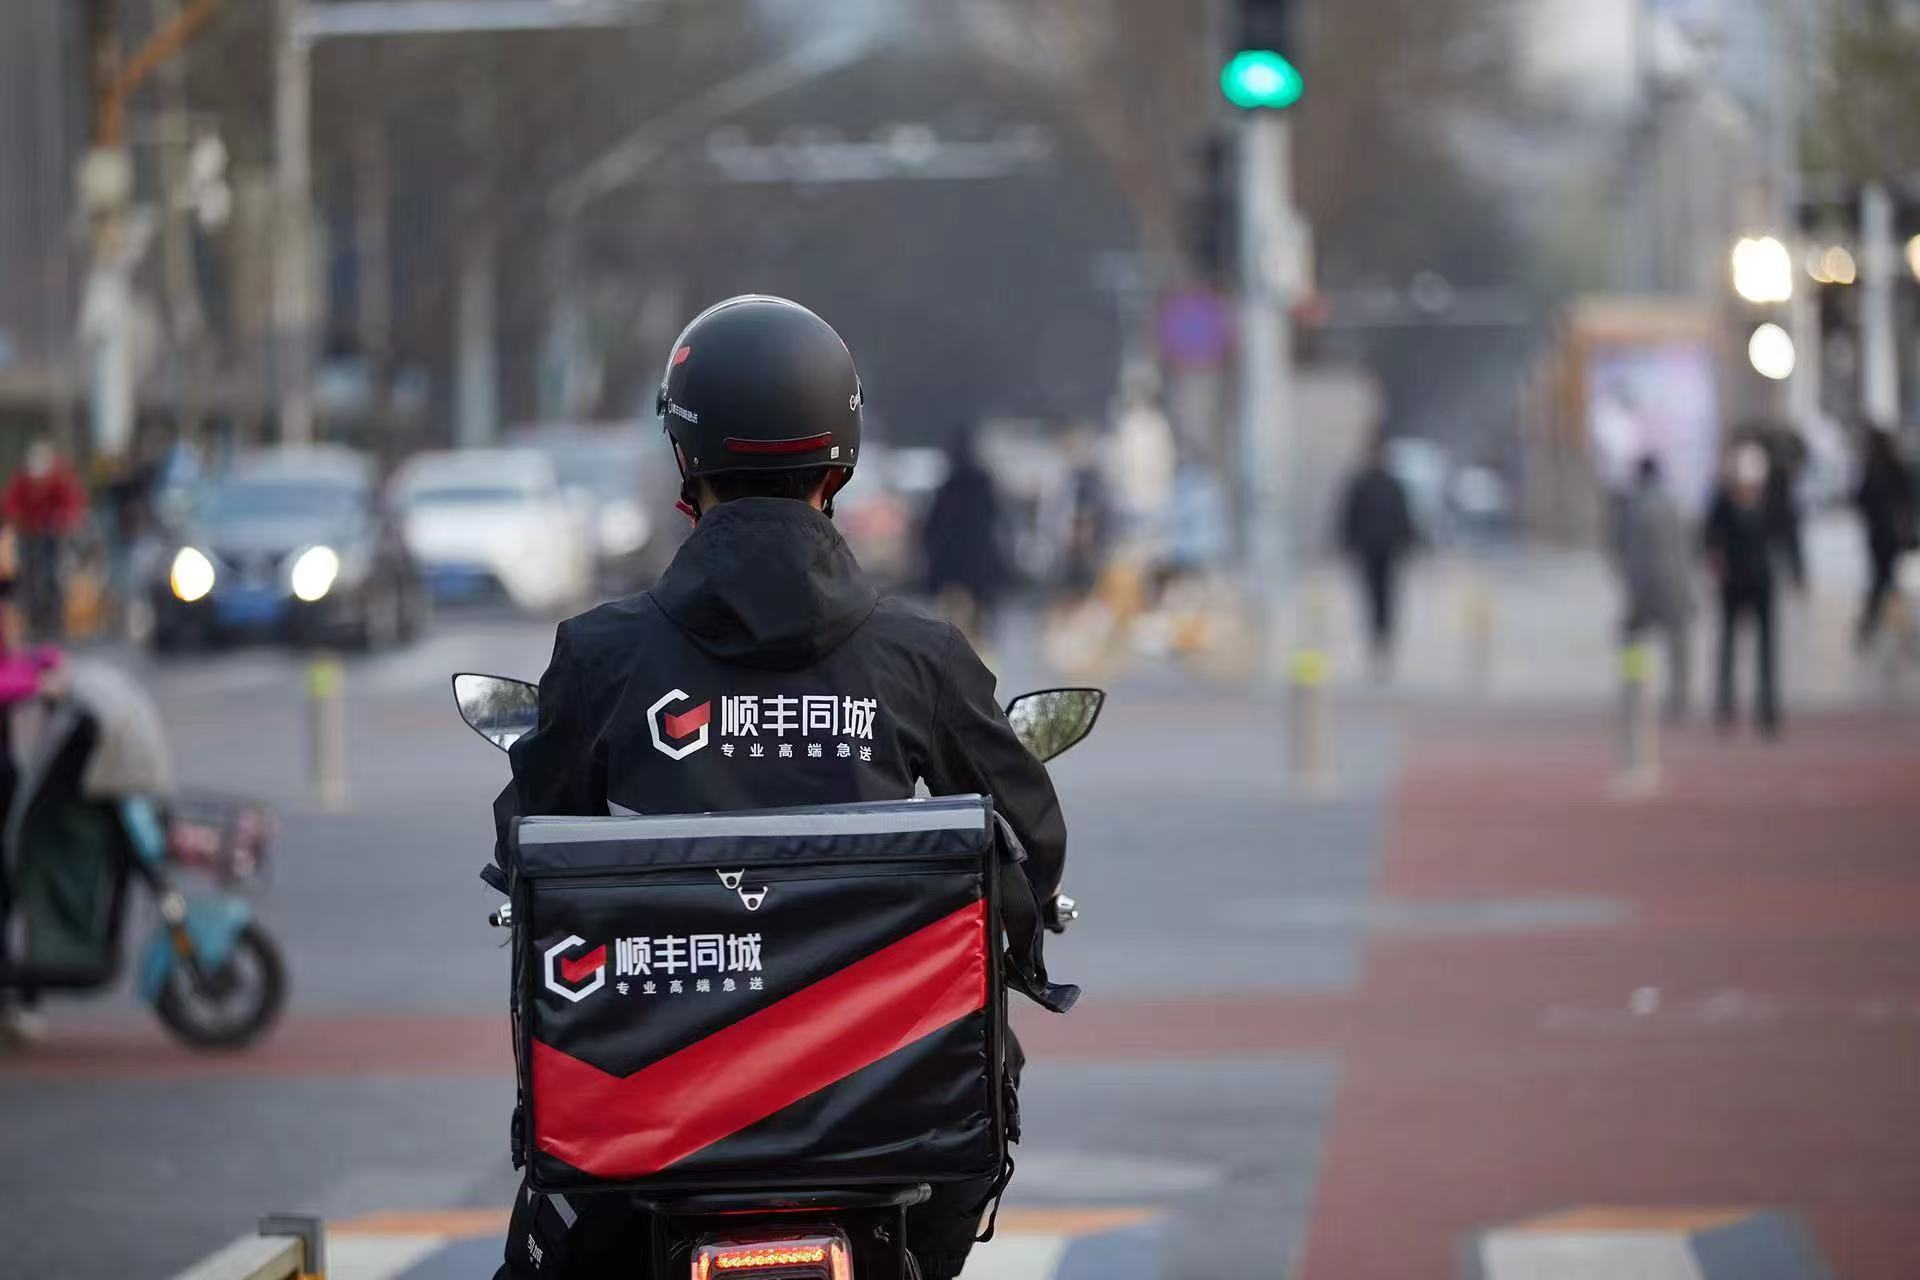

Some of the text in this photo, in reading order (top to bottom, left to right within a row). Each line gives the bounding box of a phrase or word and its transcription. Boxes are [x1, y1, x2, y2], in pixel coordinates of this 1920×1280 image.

[720, 694, 877, 740] 顺丰同城
[720, 743, 872, 762] 专业高端急送
[615, 932, 762, 977] 顺丰同城
[615, 976, 764, 996] 专业高端急送
